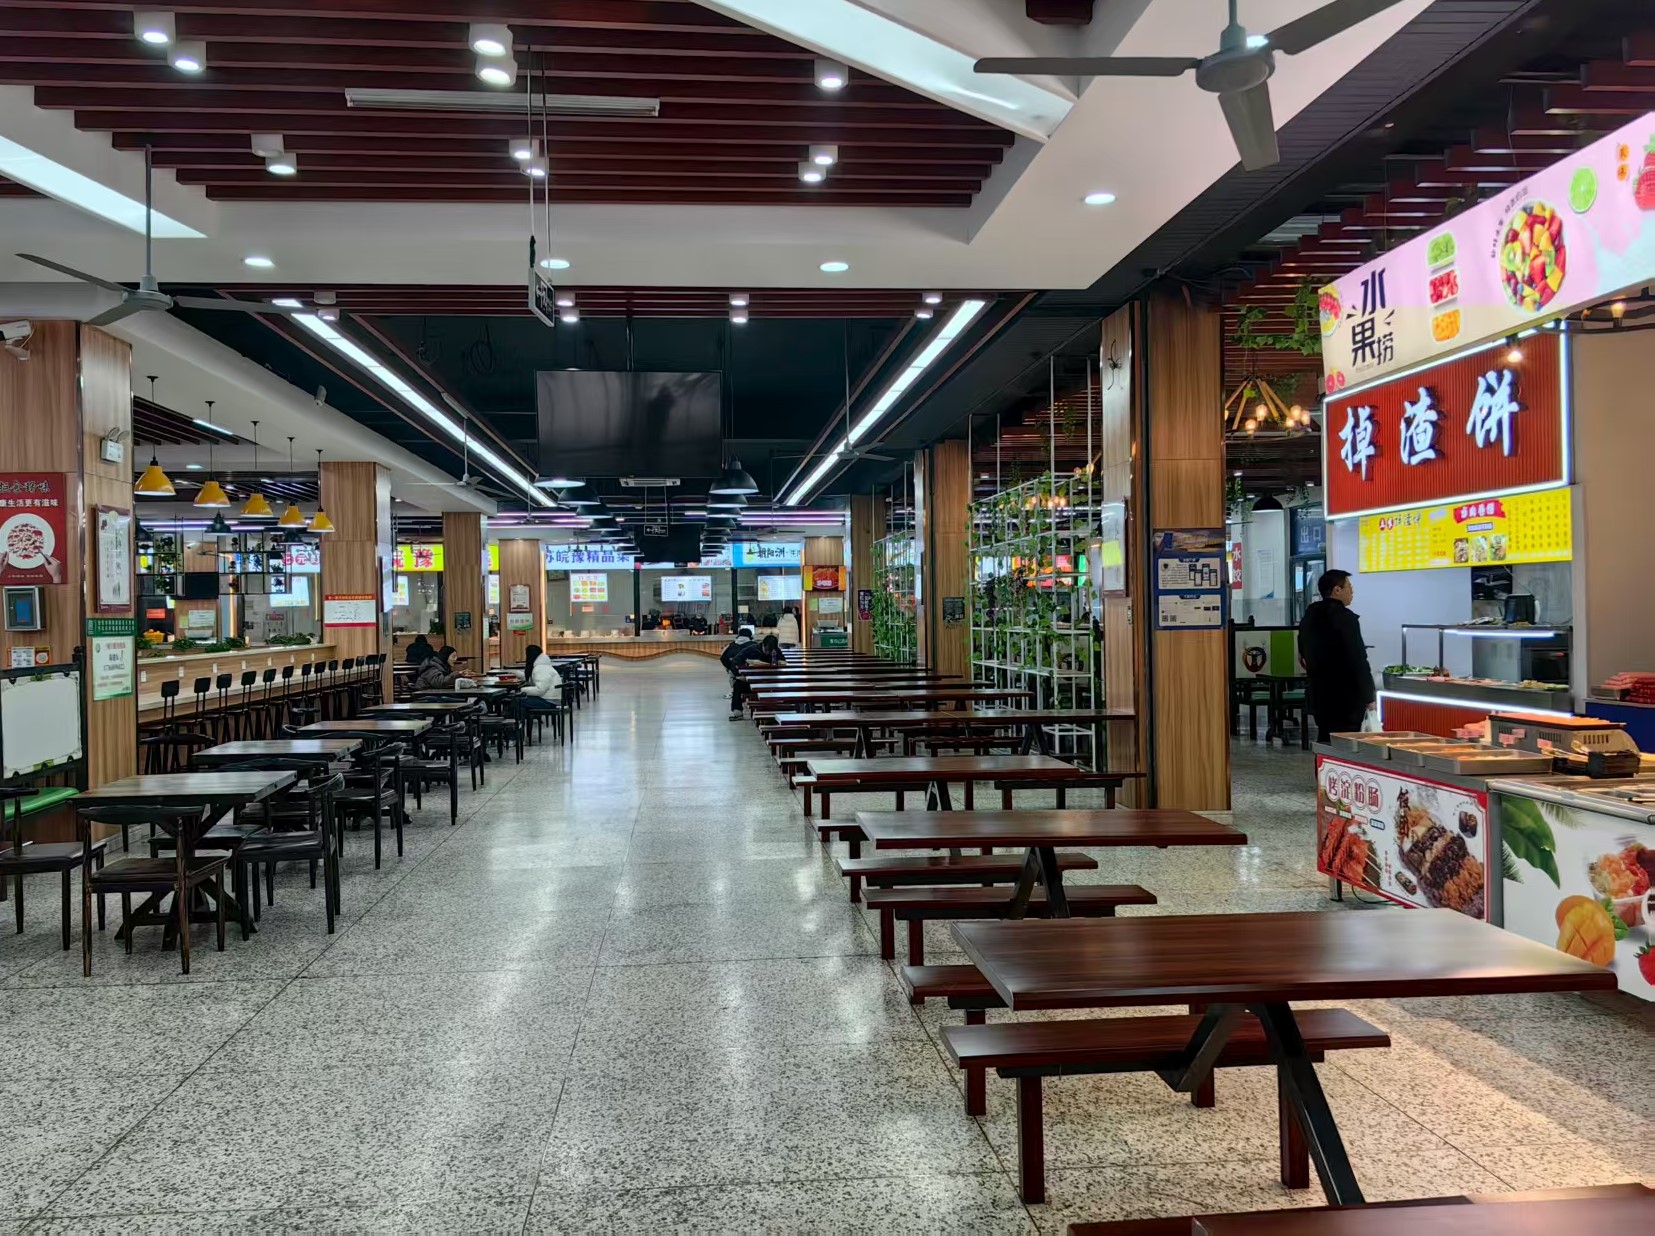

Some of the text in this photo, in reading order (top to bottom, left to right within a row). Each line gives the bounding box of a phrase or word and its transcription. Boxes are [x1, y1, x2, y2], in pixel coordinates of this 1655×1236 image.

[1352, 268, 1394, 367] 水果捞
[1338, 370, 1520, 481] 掉渣饼
[1301, 526, 1322, 544] 出口
[1328, 775, 1380, 811] 烤淀粉肠
